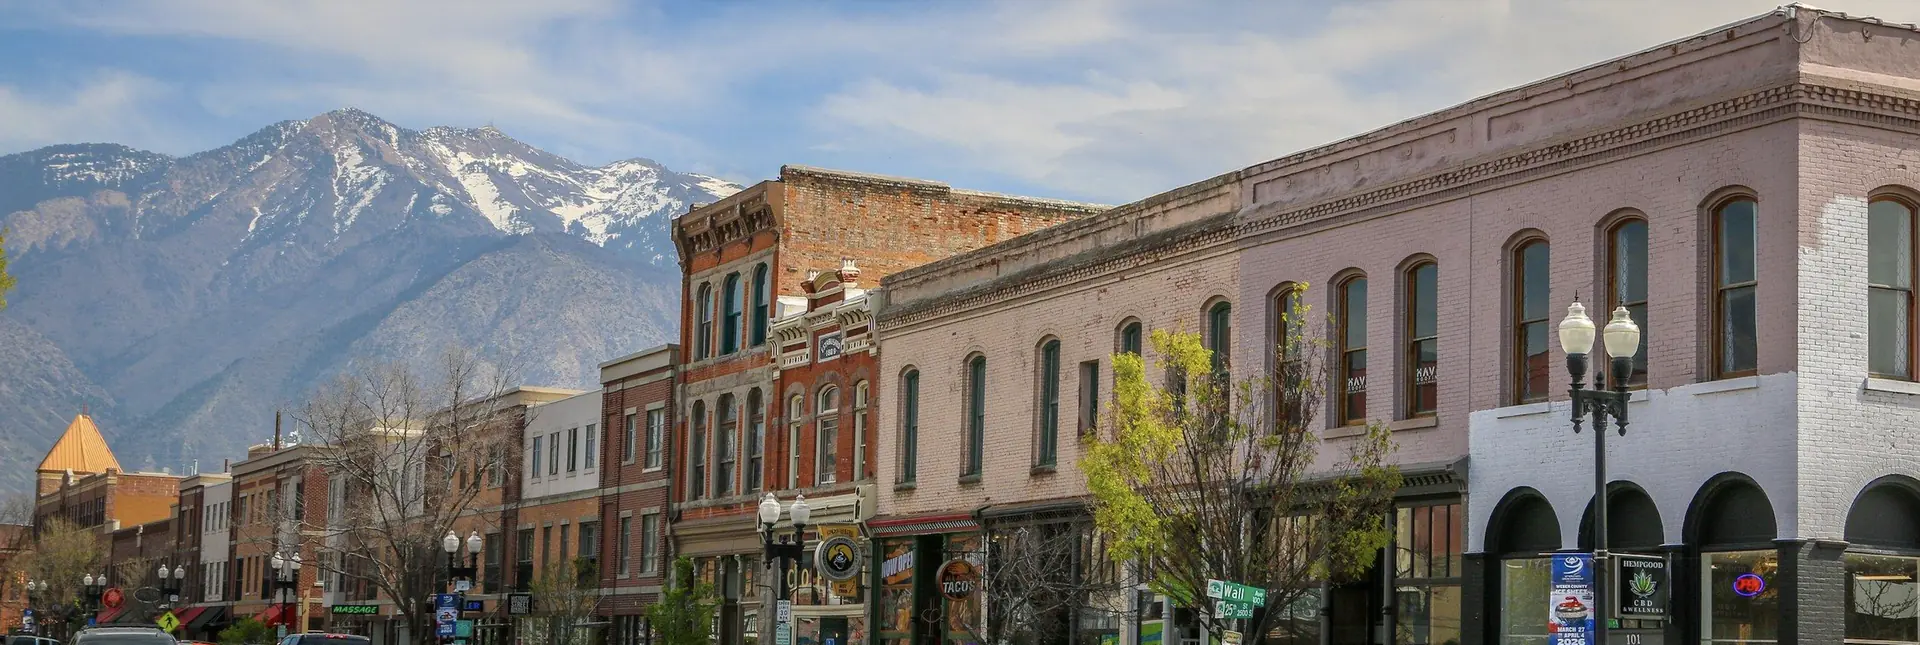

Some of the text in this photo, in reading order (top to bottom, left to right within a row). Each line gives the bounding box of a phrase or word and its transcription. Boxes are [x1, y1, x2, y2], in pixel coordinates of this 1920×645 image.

[881, 558, 897, 579] NOW
[1623, 560, 1664, 569] HEMPGOOD
[943, 580, 976, 594] TACOS
[1224, 584, 1244, 600] Wall
[1633, 599, 1653, 607] CBD
[333, 605, 378, 614] MASSAGE
[1626, 634, 1641, 645] 101
